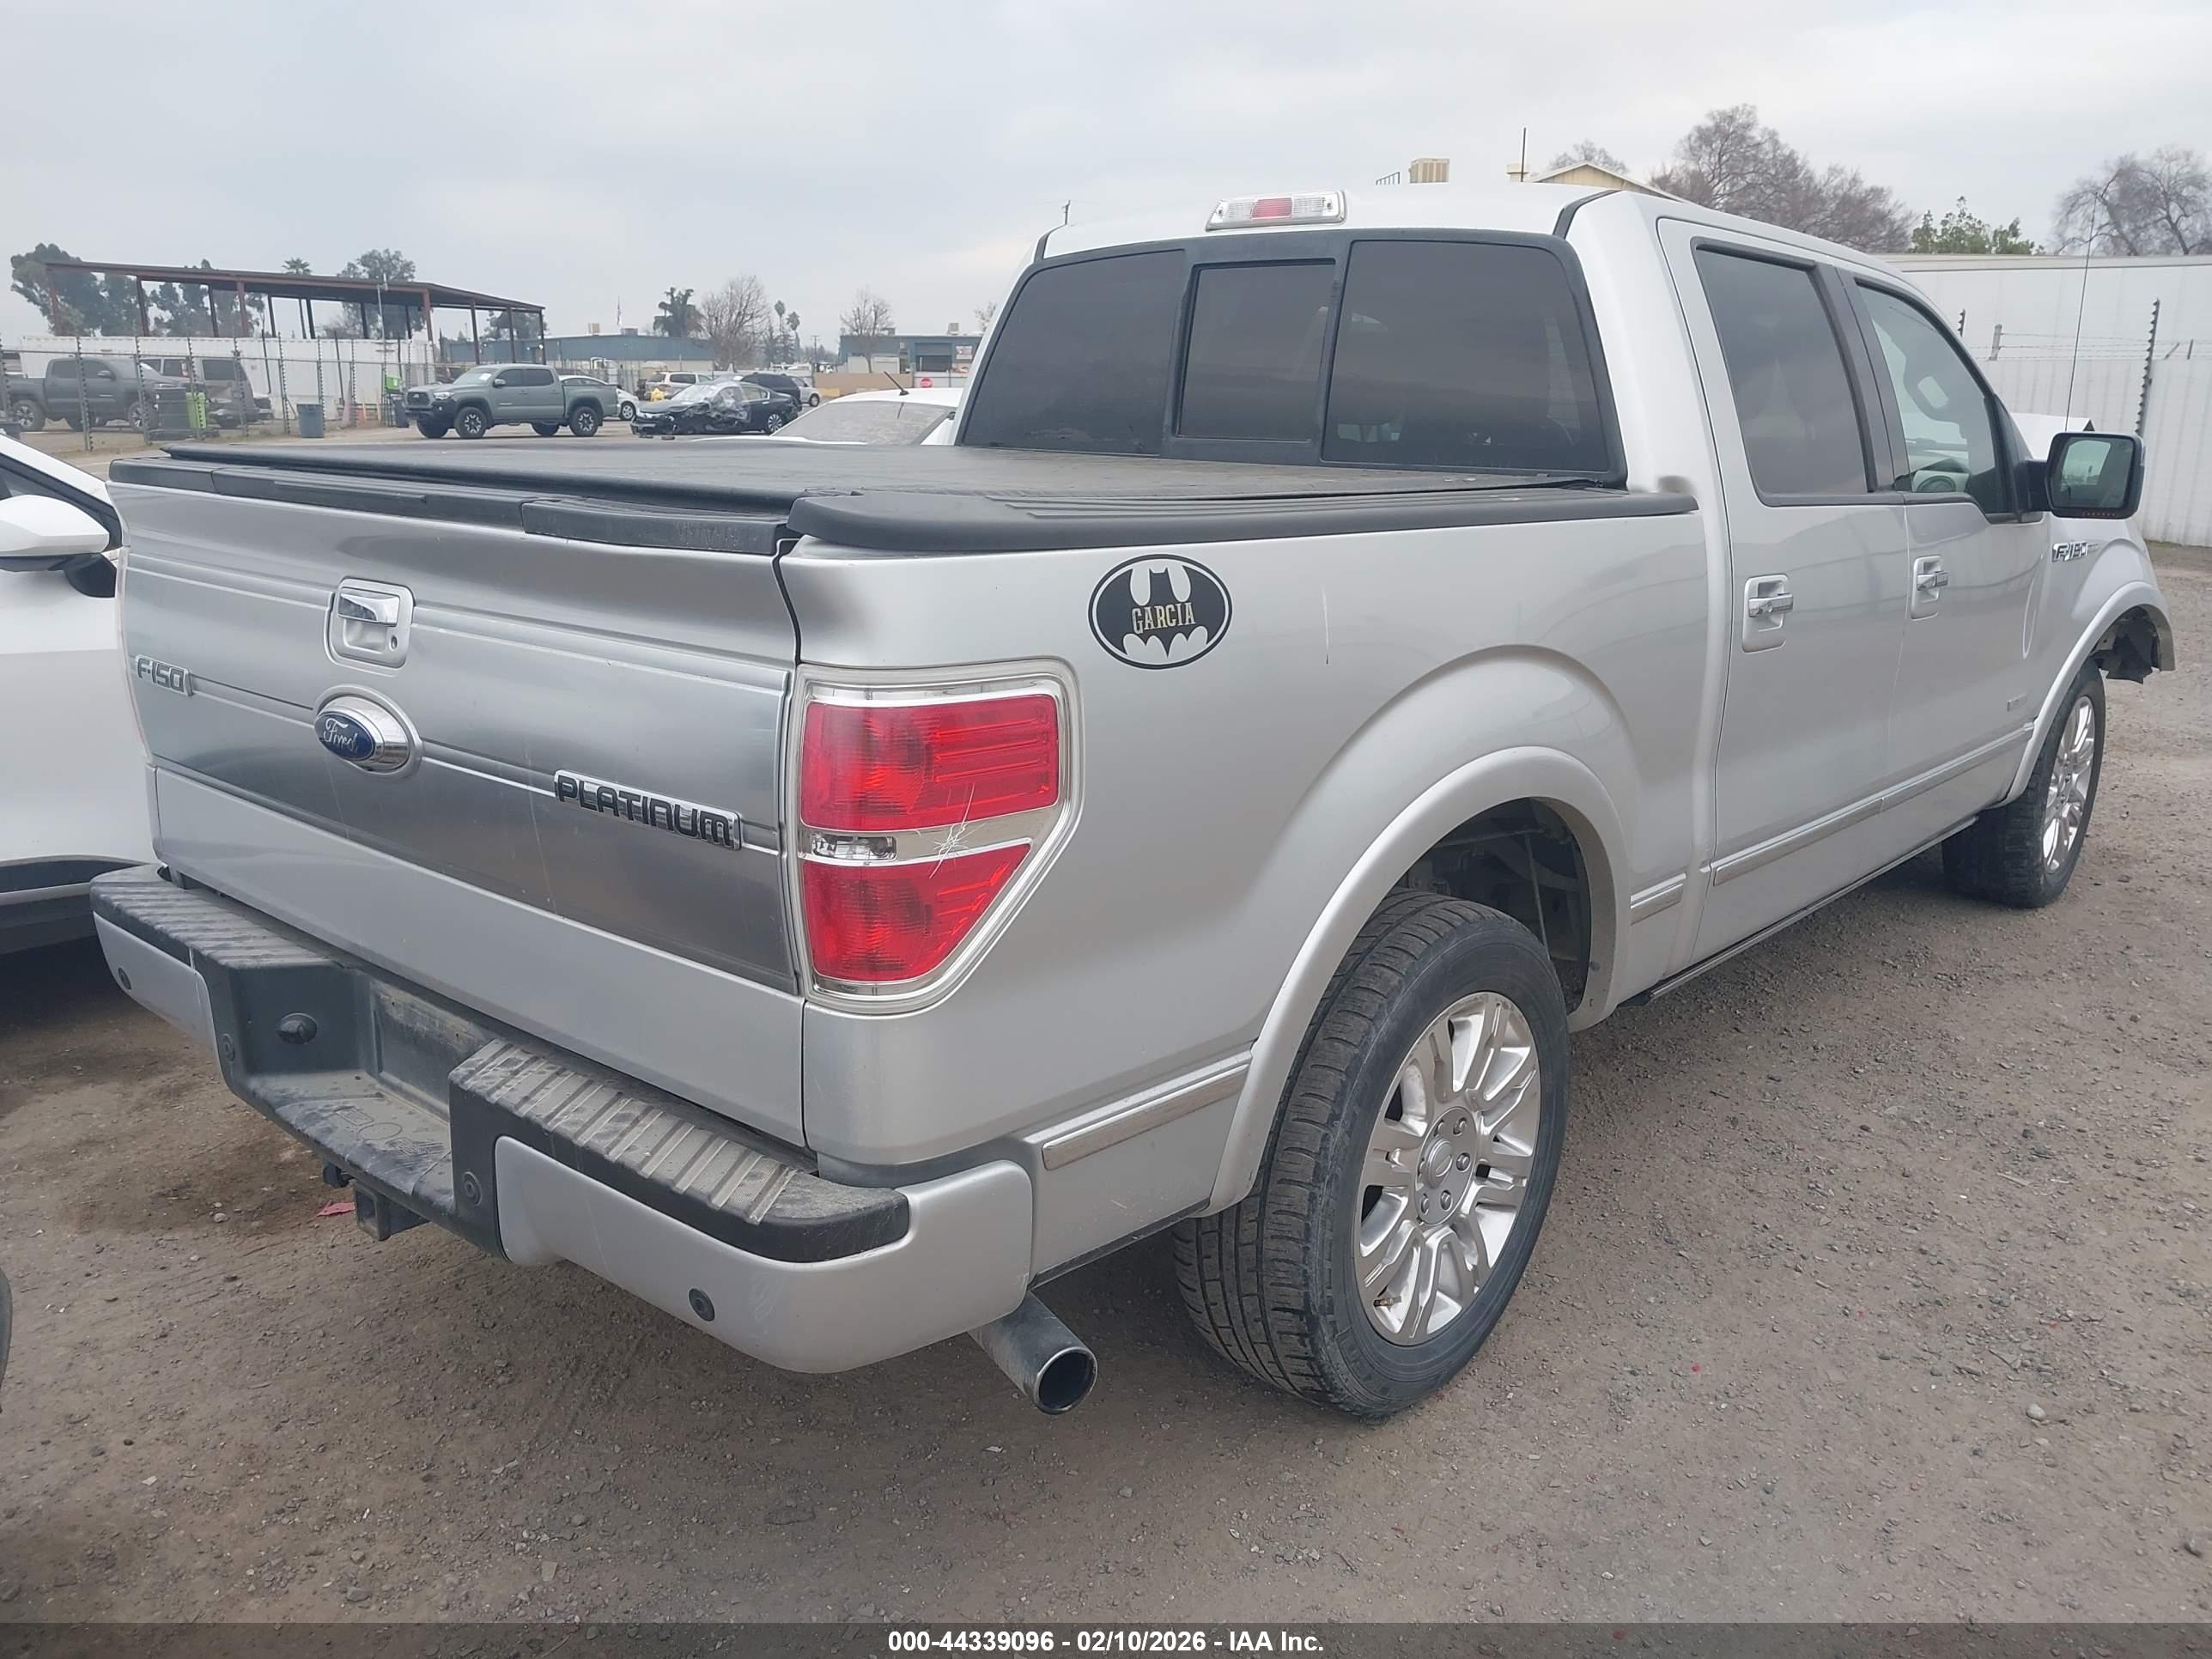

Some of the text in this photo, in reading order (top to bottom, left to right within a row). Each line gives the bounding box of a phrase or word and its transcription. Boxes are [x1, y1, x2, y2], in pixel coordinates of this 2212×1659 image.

[1131, 602, 1196, 635] GARCIA
[136, 656, 187, 694] F-150
[323, 717, 359, 753] Ford
[557, 775, 736, 848] PLATINUM
